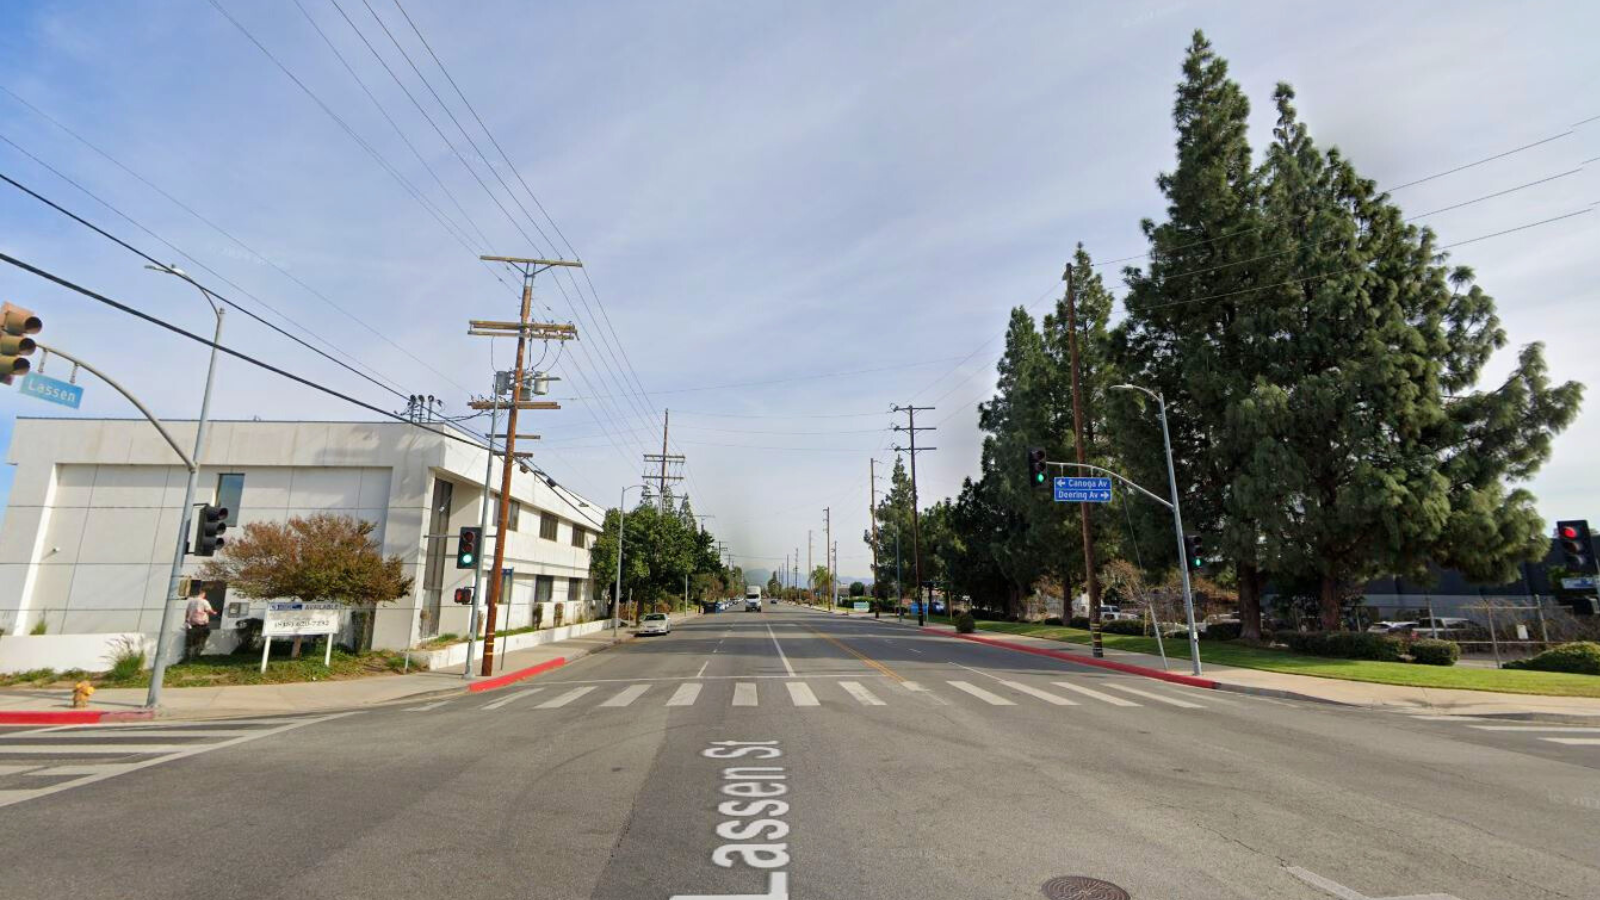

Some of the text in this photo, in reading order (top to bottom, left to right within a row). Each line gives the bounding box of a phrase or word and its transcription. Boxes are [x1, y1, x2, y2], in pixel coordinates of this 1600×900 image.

[29, 378, 76, 402] Lassen
[1068, 480, 1096, 488] Canoga
[1058, 492, 1087, 500] Deering
